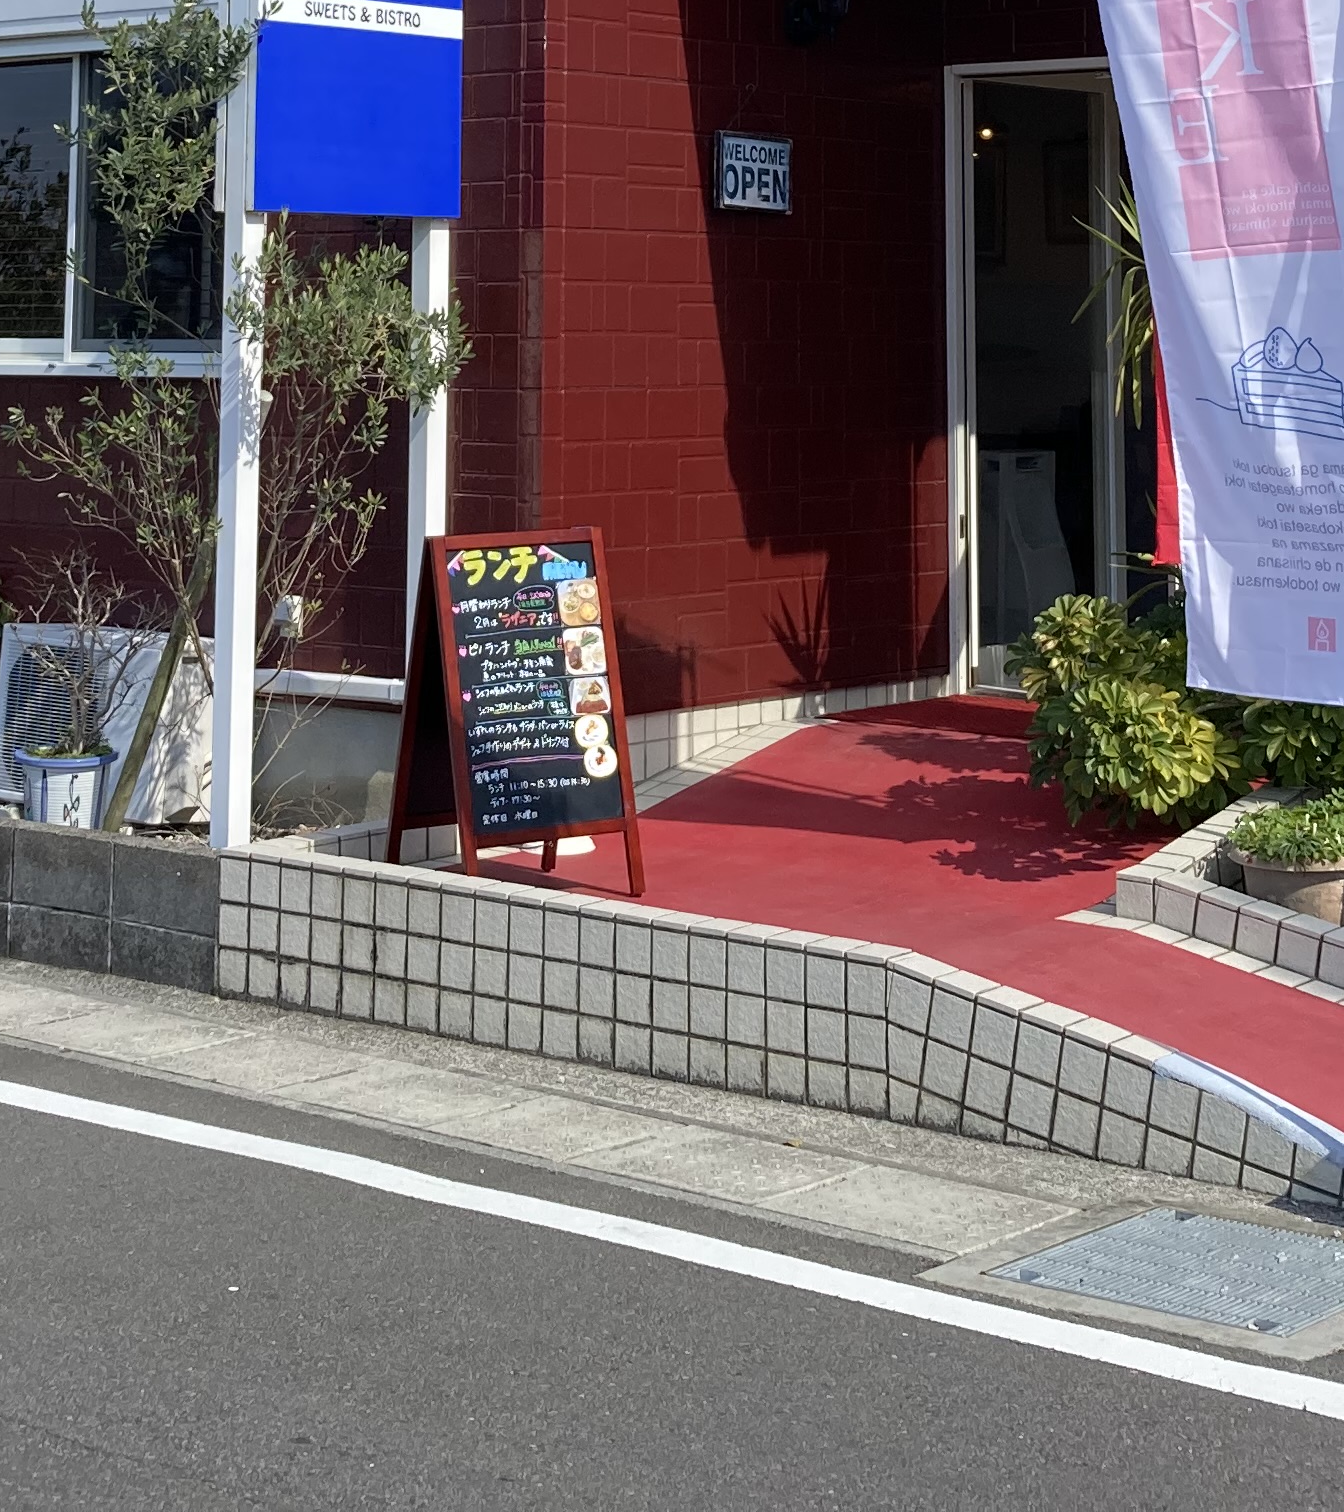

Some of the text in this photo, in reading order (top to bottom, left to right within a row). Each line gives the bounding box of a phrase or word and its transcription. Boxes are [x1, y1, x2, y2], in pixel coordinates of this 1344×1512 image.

[304, 0, 421, 28] SWEETS & BISTRO
[724, 142, 786, 166] WELCOME
[724, 164, 787, 204] OPEN
[462, 546, 538, 586] ランチ
[475, 768, 509, 784] 営業時間
